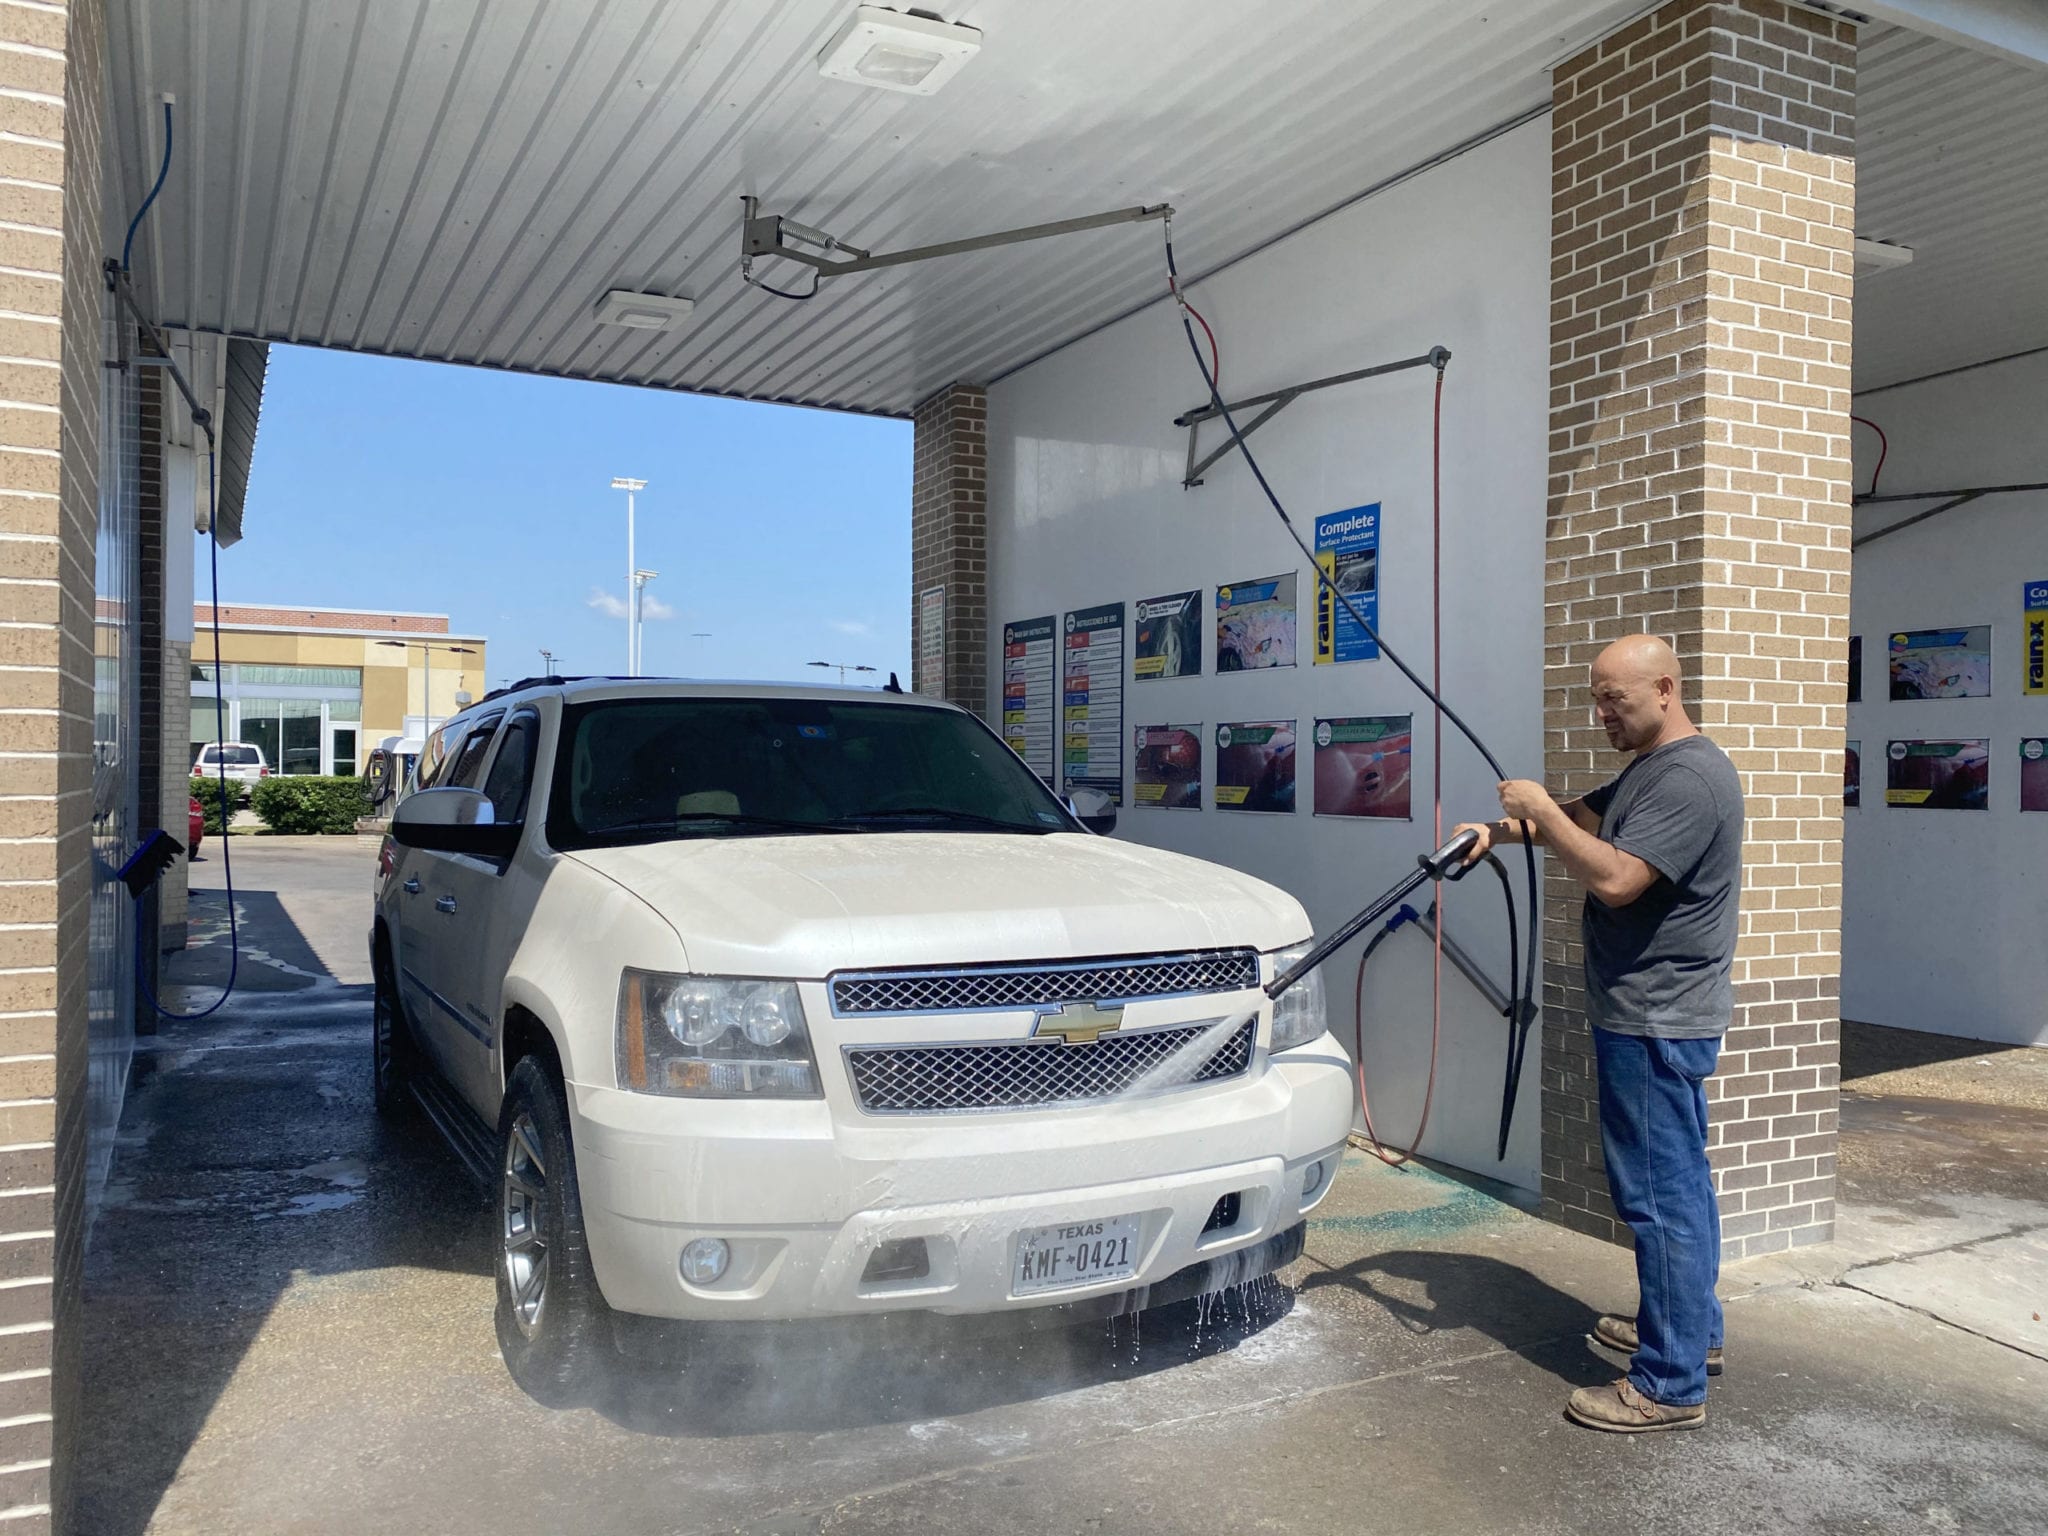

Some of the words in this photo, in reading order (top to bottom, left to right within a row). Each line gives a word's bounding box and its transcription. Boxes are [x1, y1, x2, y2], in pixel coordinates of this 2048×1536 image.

[1320, 515, 1375, 537] Complete
[1320, 538, 1341, 548] Surface
[1341, 531, 1375, 544] Protectant
[1057, 1223, 1104, 1240] TEXAS
